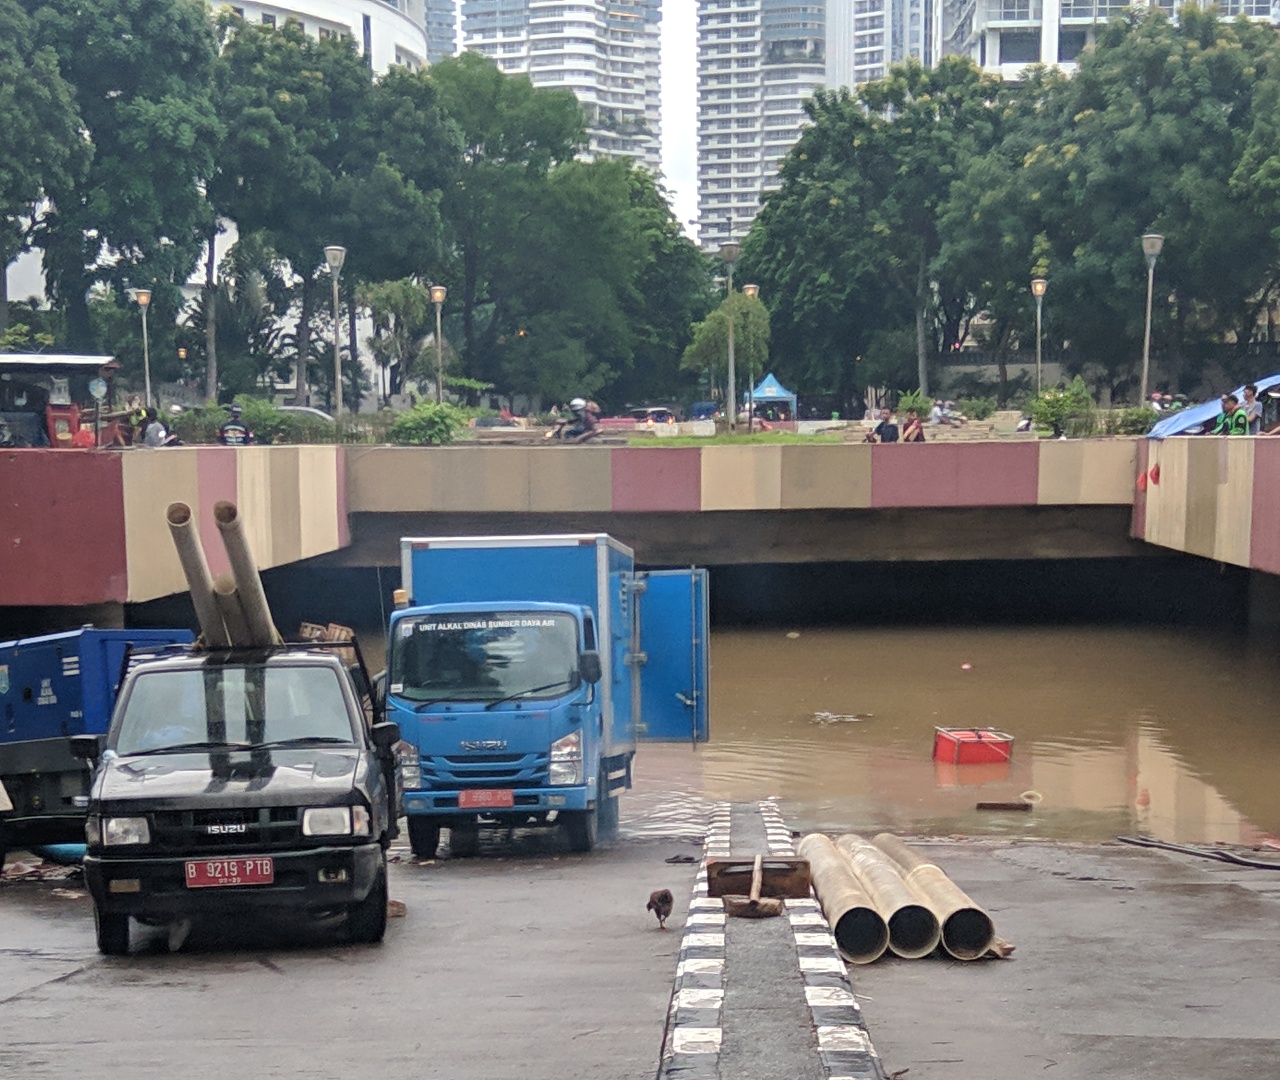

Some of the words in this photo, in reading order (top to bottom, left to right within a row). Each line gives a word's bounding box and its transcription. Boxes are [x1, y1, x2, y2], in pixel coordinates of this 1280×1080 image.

[419, 623, 437, 631] UNIT
[488, 620, 520, 629] SUMBER
[521, 619, 541, 628] DAYA
[460, 740, 508, 750] ISUZU
[207, 824, 246, 835] ISUZU
[188, 863, 196, 878] B
[206, 861, 238, 877] 9219
[246, 860, 271, 876] PTB
